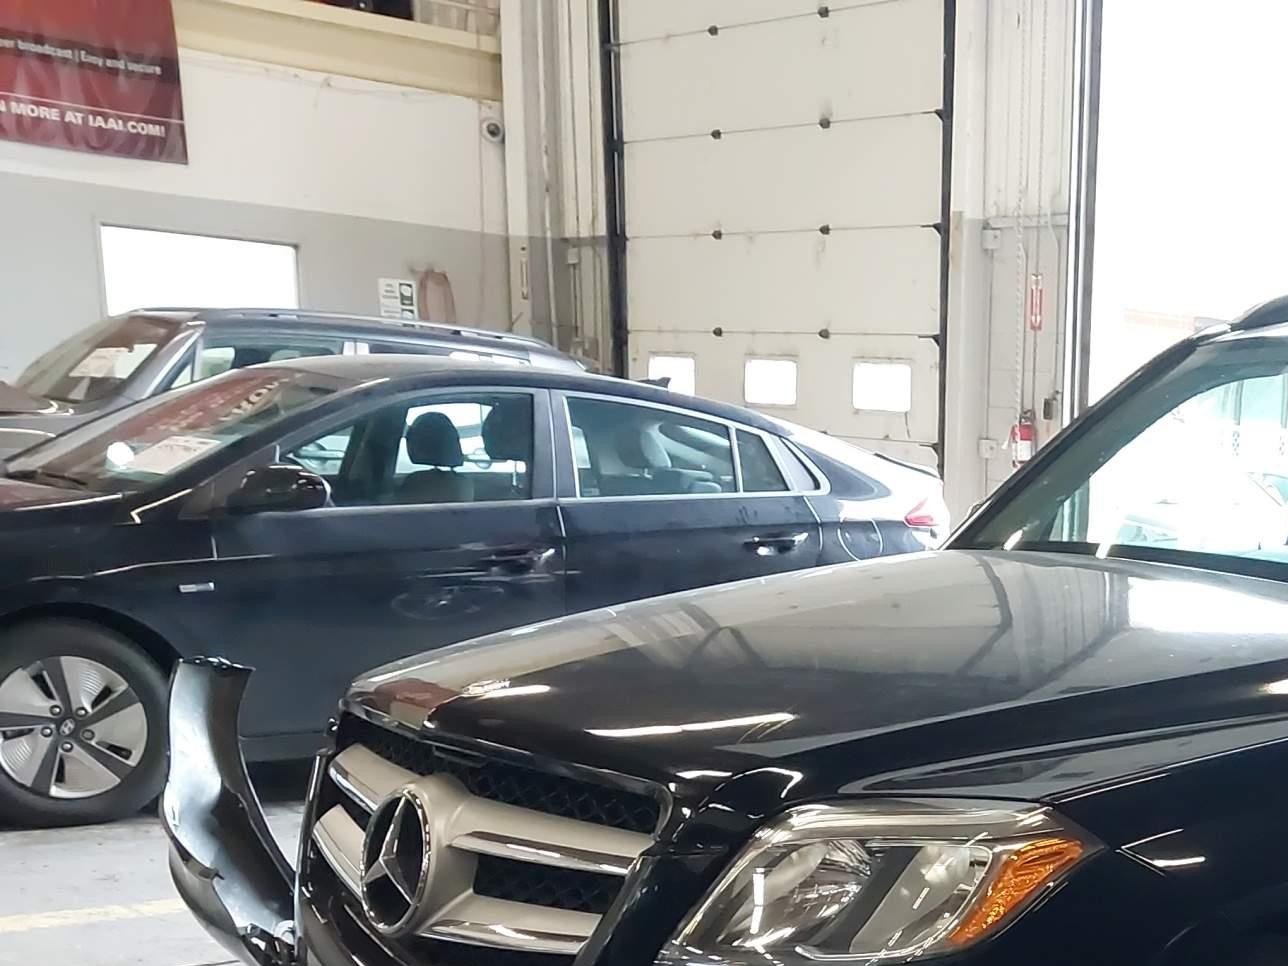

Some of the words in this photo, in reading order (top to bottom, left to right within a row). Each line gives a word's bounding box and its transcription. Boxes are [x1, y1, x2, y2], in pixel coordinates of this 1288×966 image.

[105, 58, 126, 70] and
[10, 102, 60, 121] MORE
[64, 111, 84, 125] AT
[88, 115, 166, 138] IAAI.COM!
